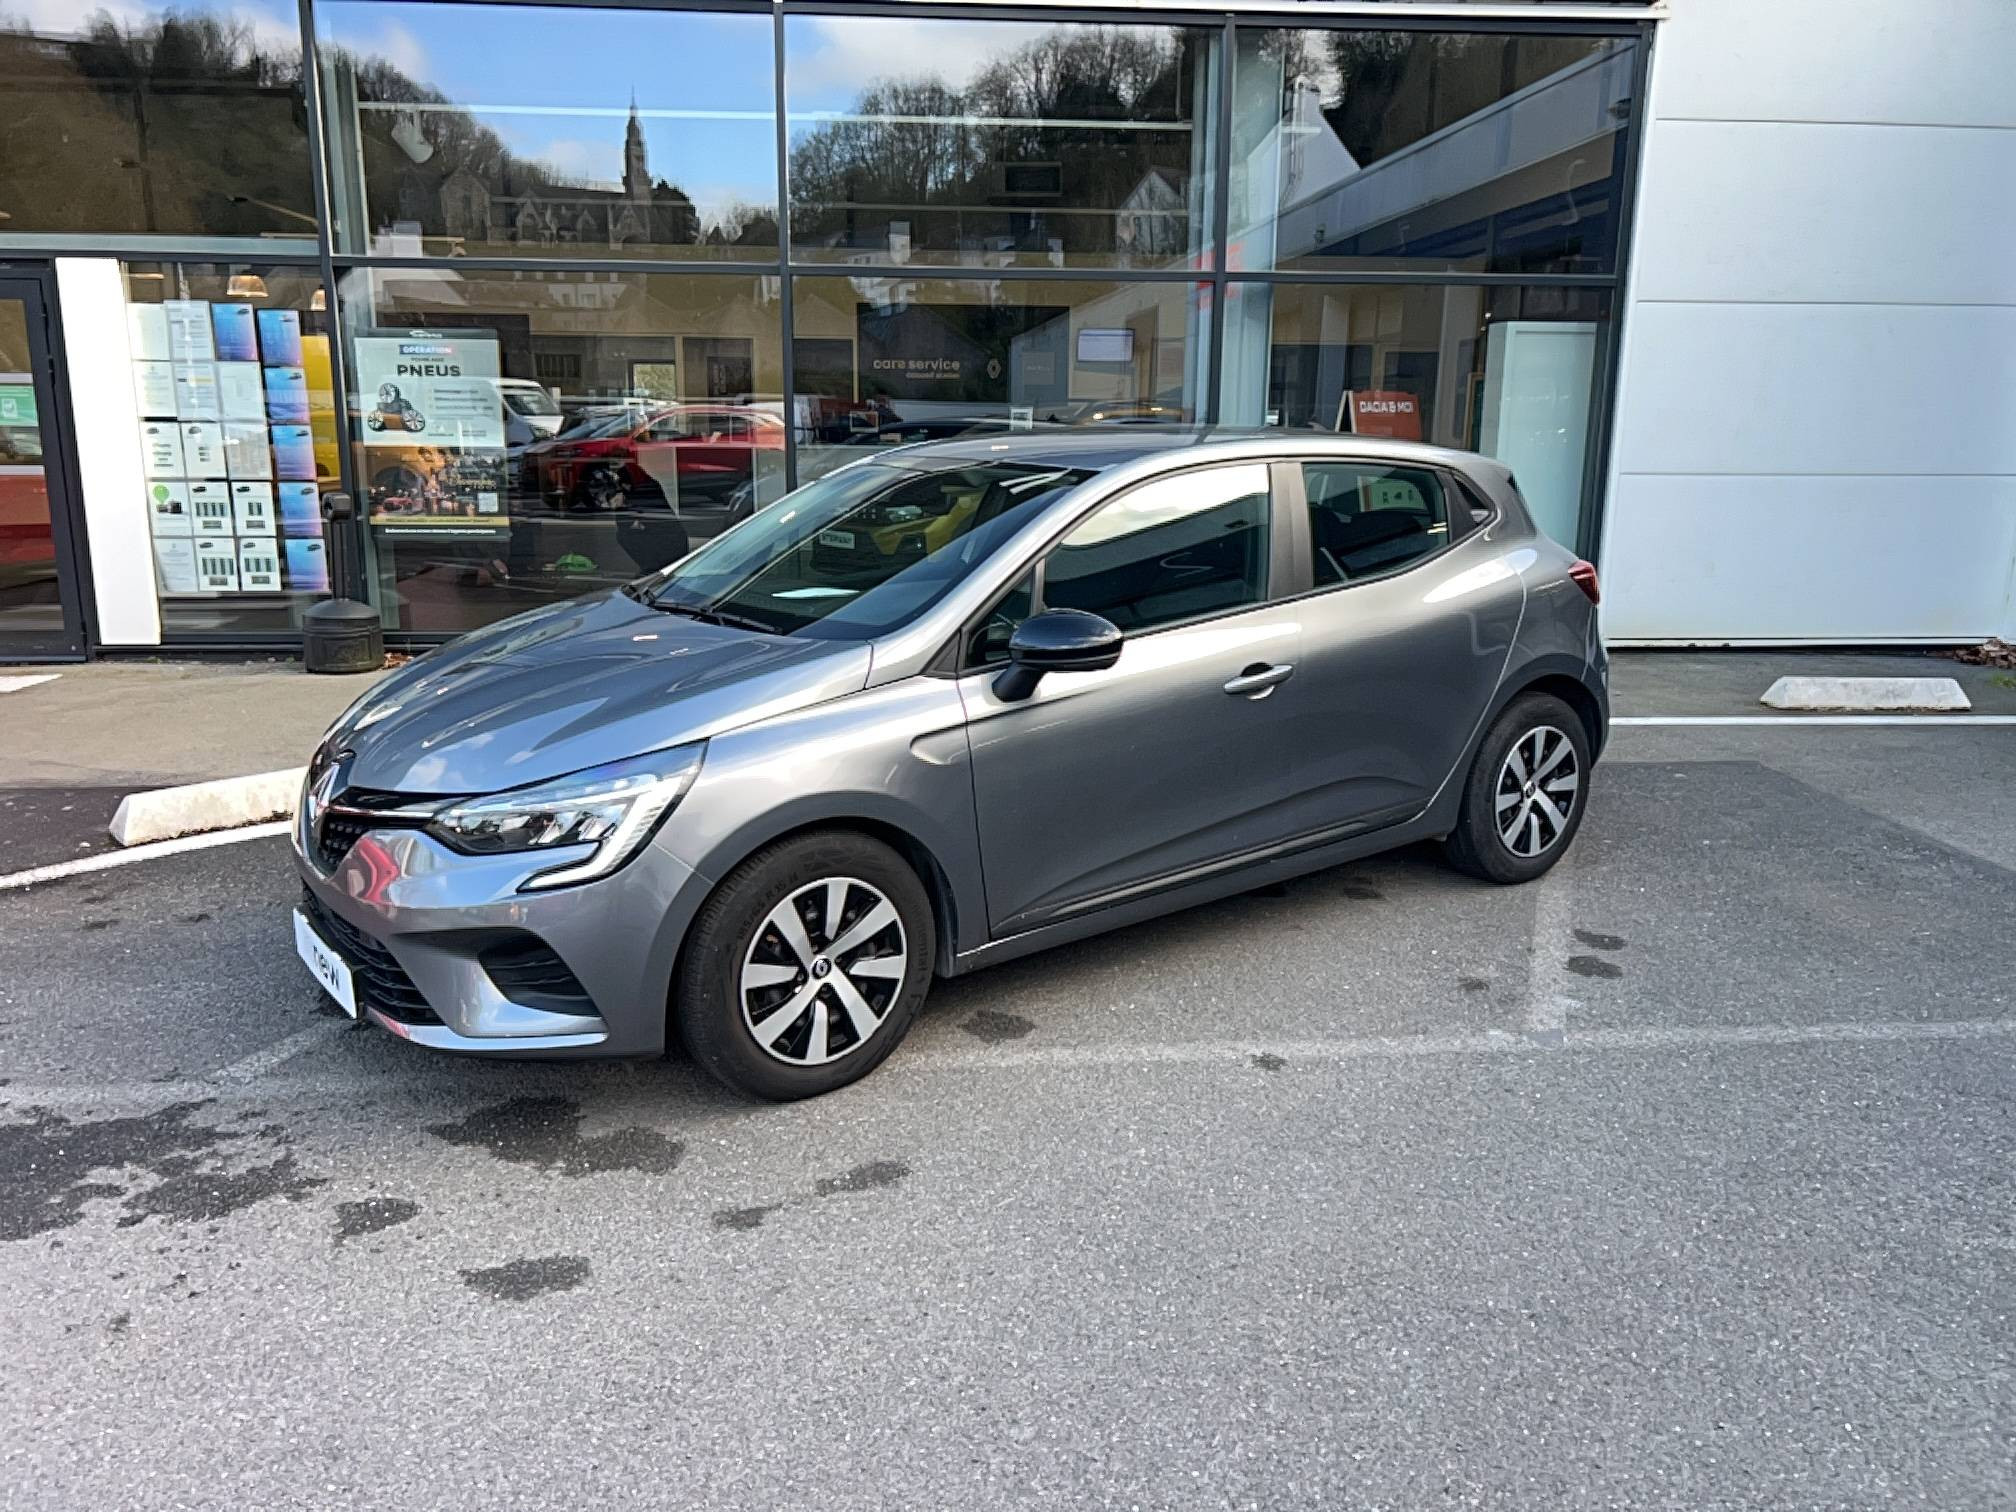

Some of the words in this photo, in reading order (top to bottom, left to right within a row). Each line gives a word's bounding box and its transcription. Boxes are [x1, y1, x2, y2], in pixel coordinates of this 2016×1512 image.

[397, 364, 462, 377] PNEUS
[873, 359, 906, 370] care
[908, 358, 960, 371] service
